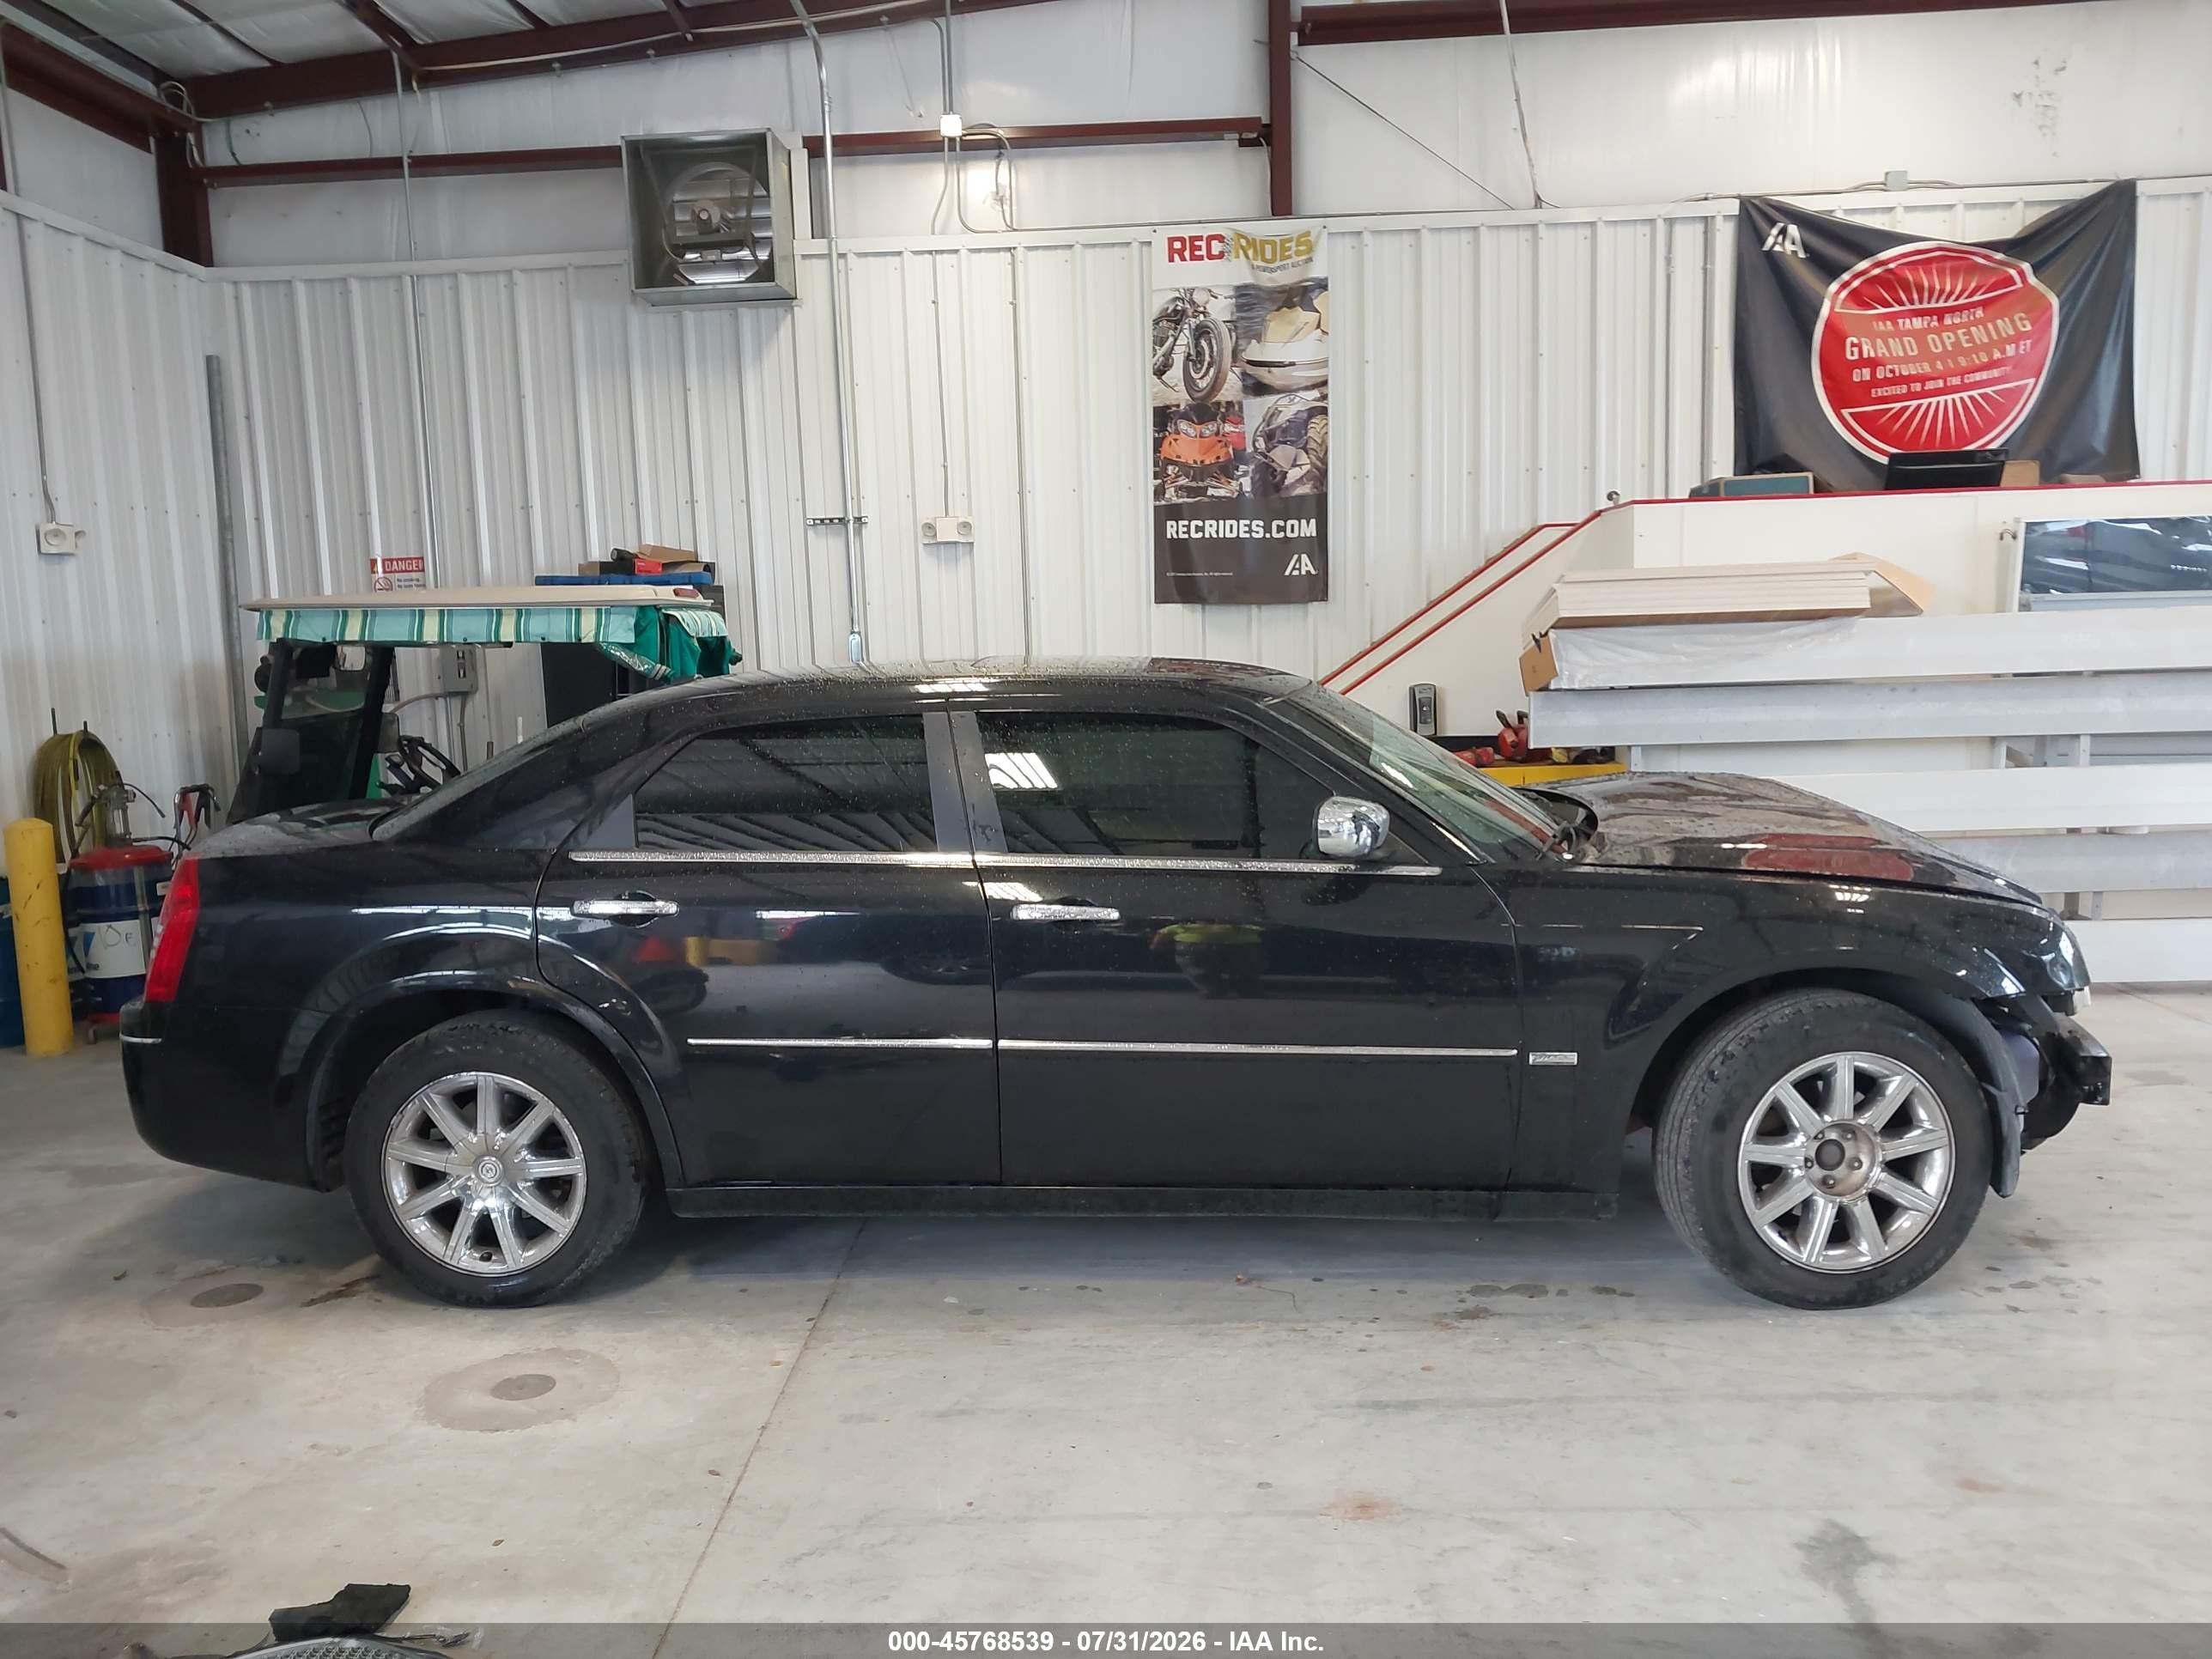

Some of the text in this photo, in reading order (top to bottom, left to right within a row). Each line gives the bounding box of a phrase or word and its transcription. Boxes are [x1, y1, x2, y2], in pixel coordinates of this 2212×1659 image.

[1167, 230, 1313, 264] REC RIDES
[1897, 315, 1939, 331] TAMPA
[1943, 306, 1984, 325] NORTH
[1845, 312, 2032, 360] GRAND OPENING
[1852, 368, 1871, 382] ON
[1876, 362, 1931, 379] OCTOBER
[1166, 518, 1317, 539] RECRIDES.COM
